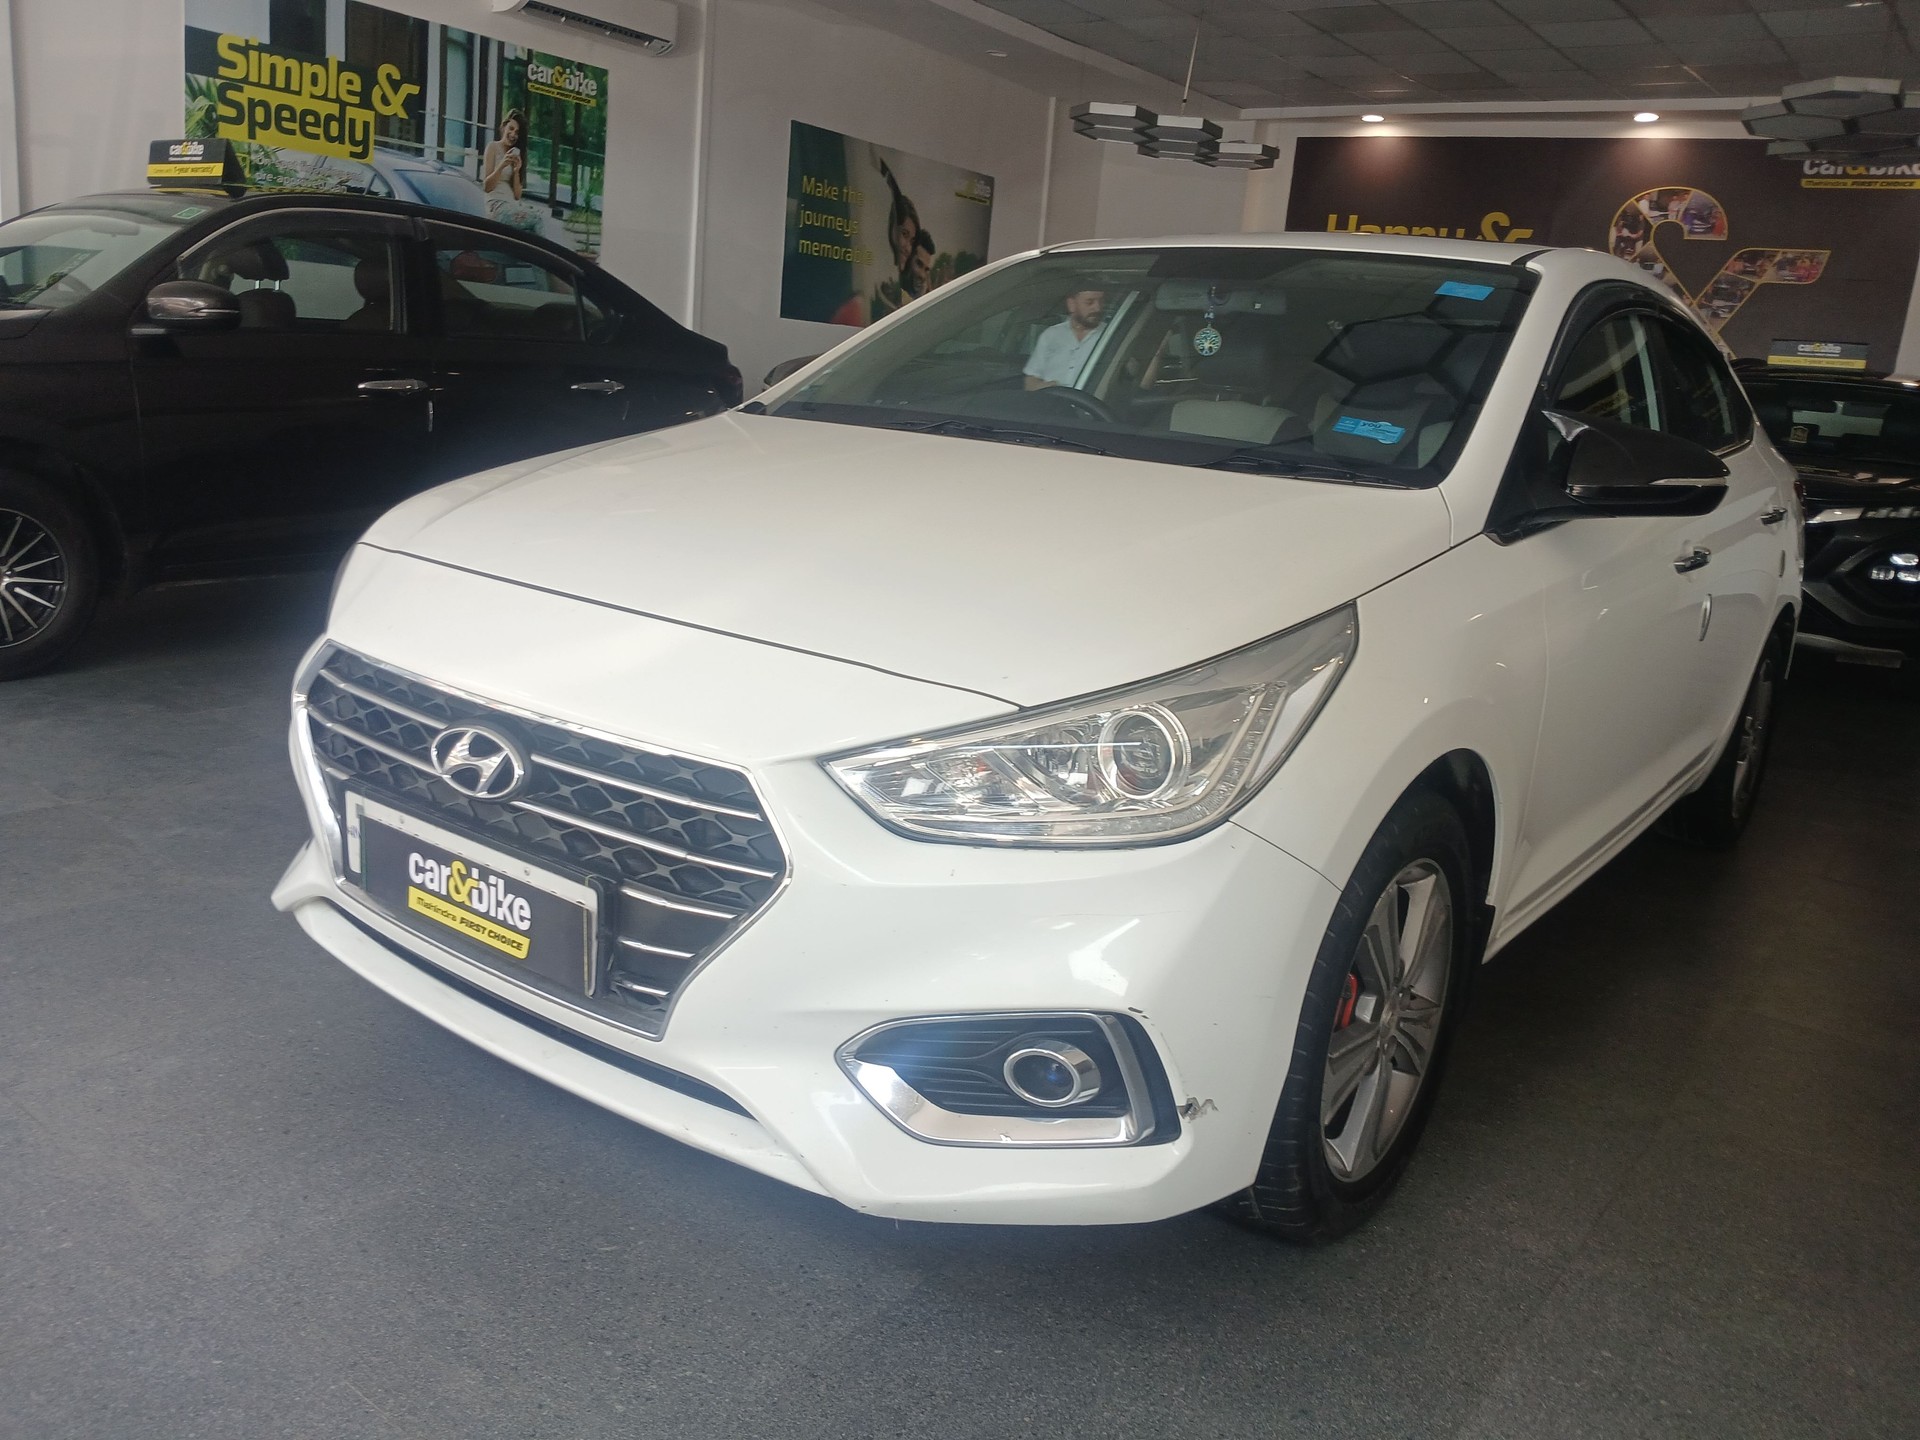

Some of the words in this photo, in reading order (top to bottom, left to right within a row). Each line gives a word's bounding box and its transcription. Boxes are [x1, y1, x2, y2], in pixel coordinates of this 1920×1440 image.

[217, 34, 361, 104] Simple
[371, 63, 420, 120] &
[528, 64, 597, 96] car&bike
[218, 81, 370, 160] Speedy
[802, 175, 839, 201] Make
[799, 204, 859, 236] journeys
[408, 852, 531, 931] car&bike
[458, 916, 487, 935] FIRST
[487, 928, 524, 952] CHOICE
